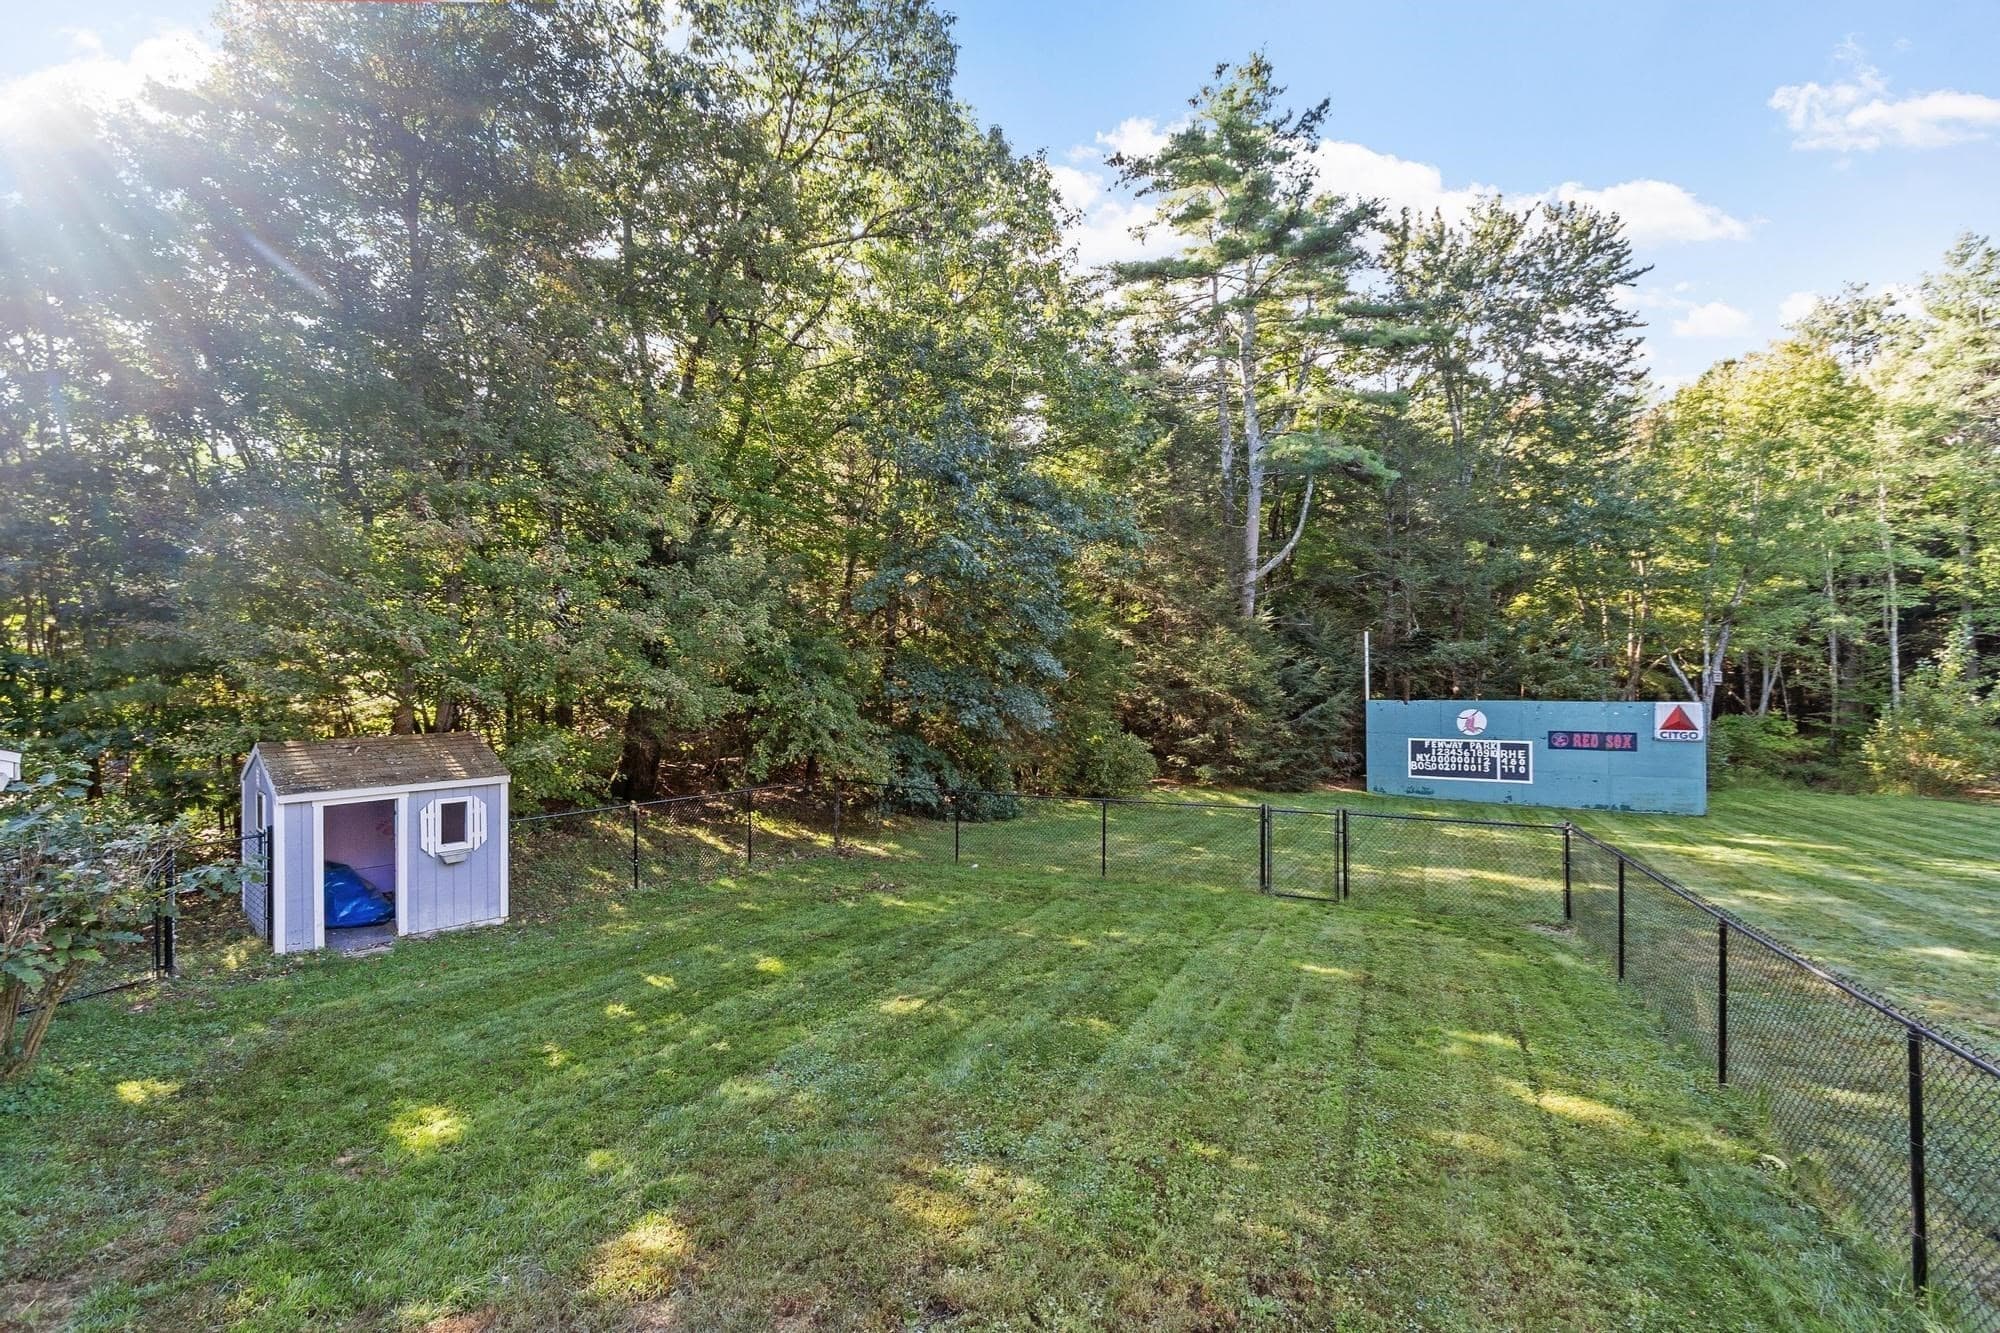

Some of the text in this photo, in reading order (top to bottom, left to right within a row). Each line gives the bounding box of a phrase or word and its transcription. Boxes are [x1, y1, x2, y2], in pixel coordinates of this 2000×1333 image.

[1659, 731, 1699, 740] CITGO
[1424, 740, 1497, 750] FENWAY PARK
[1572, 734, 1633, 749] RED SOX
